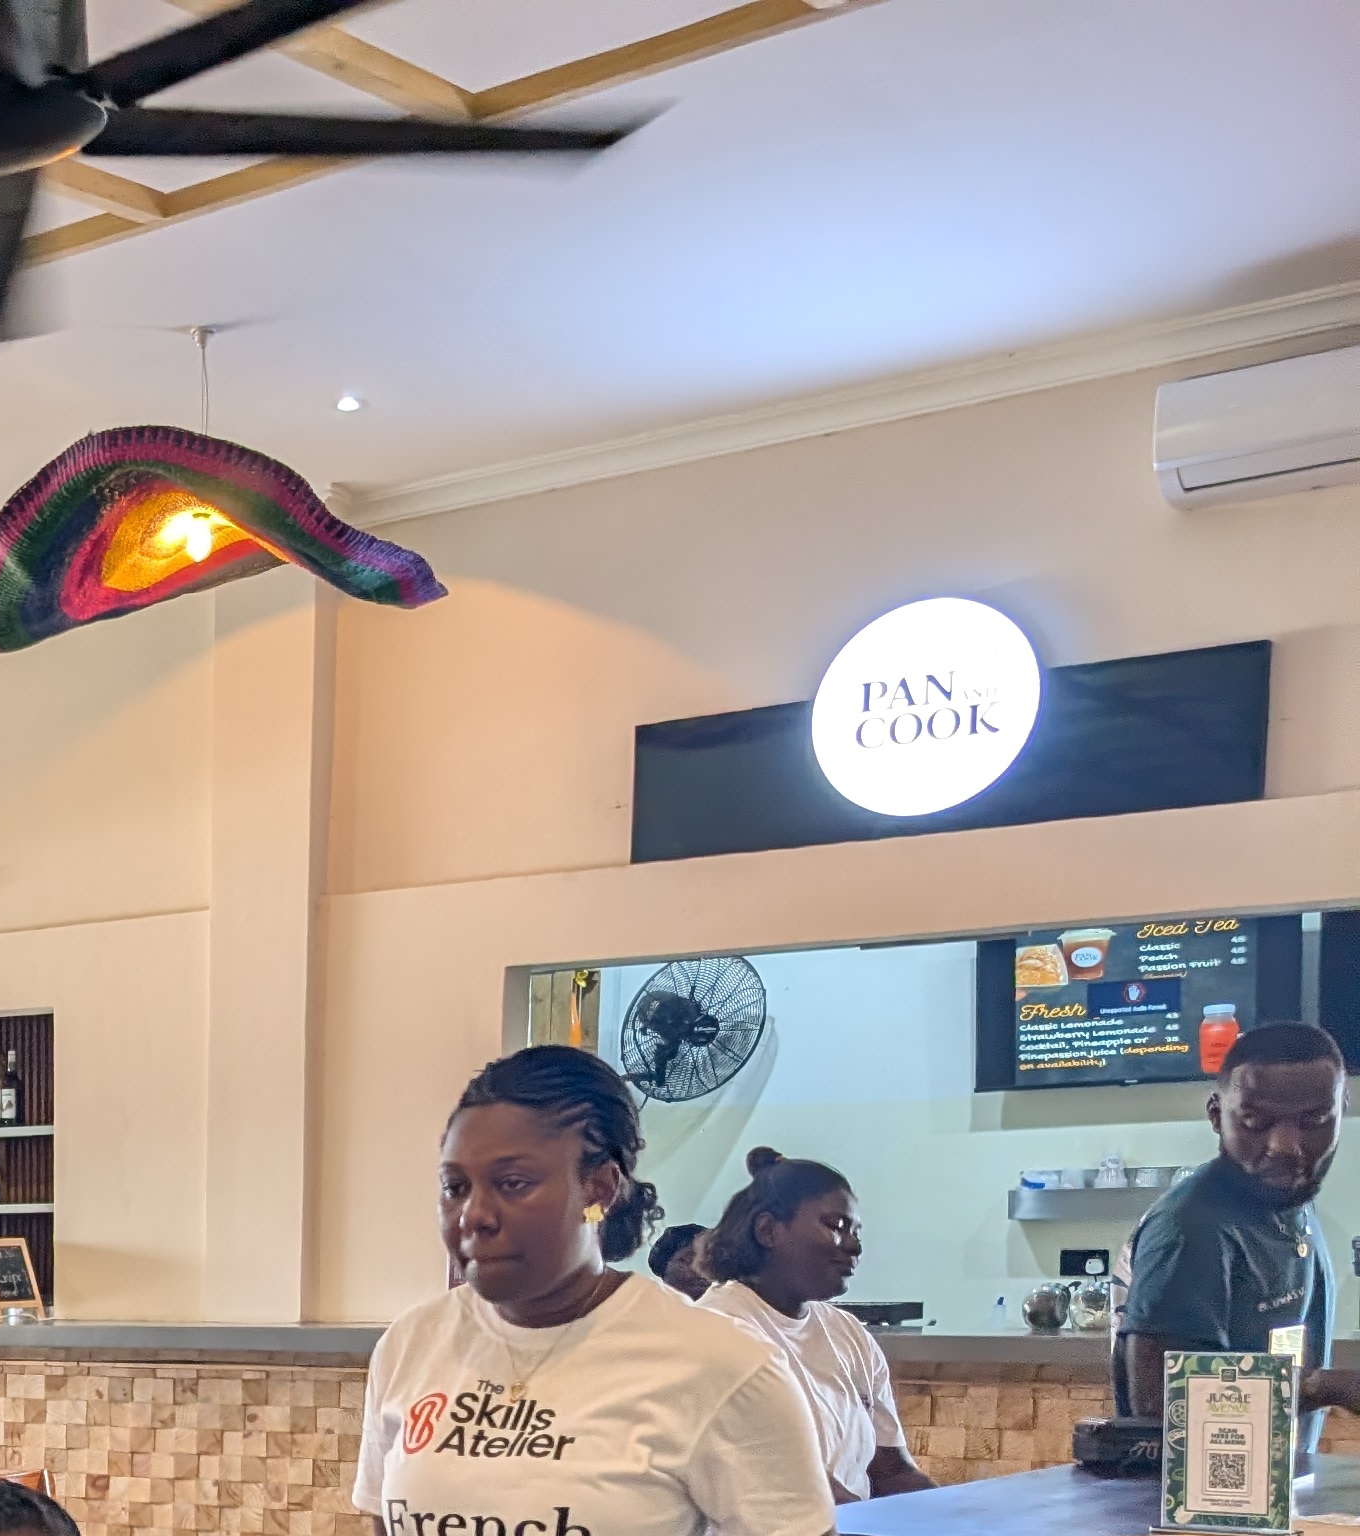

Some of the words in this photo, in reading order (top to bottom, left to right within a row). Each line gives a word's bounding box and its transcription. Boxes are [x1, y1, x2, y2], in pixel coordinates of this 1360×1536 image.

[861, 671, 955, 712] PAN
[855, 701, 1000, 748] COOK
[1137, 923, 1189, 939] Iced
[1194, 919, 1240, 934] Tea
[1138, 943, 1181, 952] Classic
[1138, 953, 1178, 963] Peach
[1137, 962, 1187, 973] Passion
[1019, 1003, 1087, 1021] Fresh
[1019, 1023, 1058, 1032] Classic
[1060, 1018, 1124, 1029] Lemonade
[1019, 1031, 1090, 1042] Strawberry
[1092, 1026, 1157, 1037] Lemonade
[1071, 1038, 1132, 1048] Pineapple
[477, 1379, 505, 1395] The
[450, 1392, 556, 1434] Skills
[434, 1426, 576, 1460] Atelier
